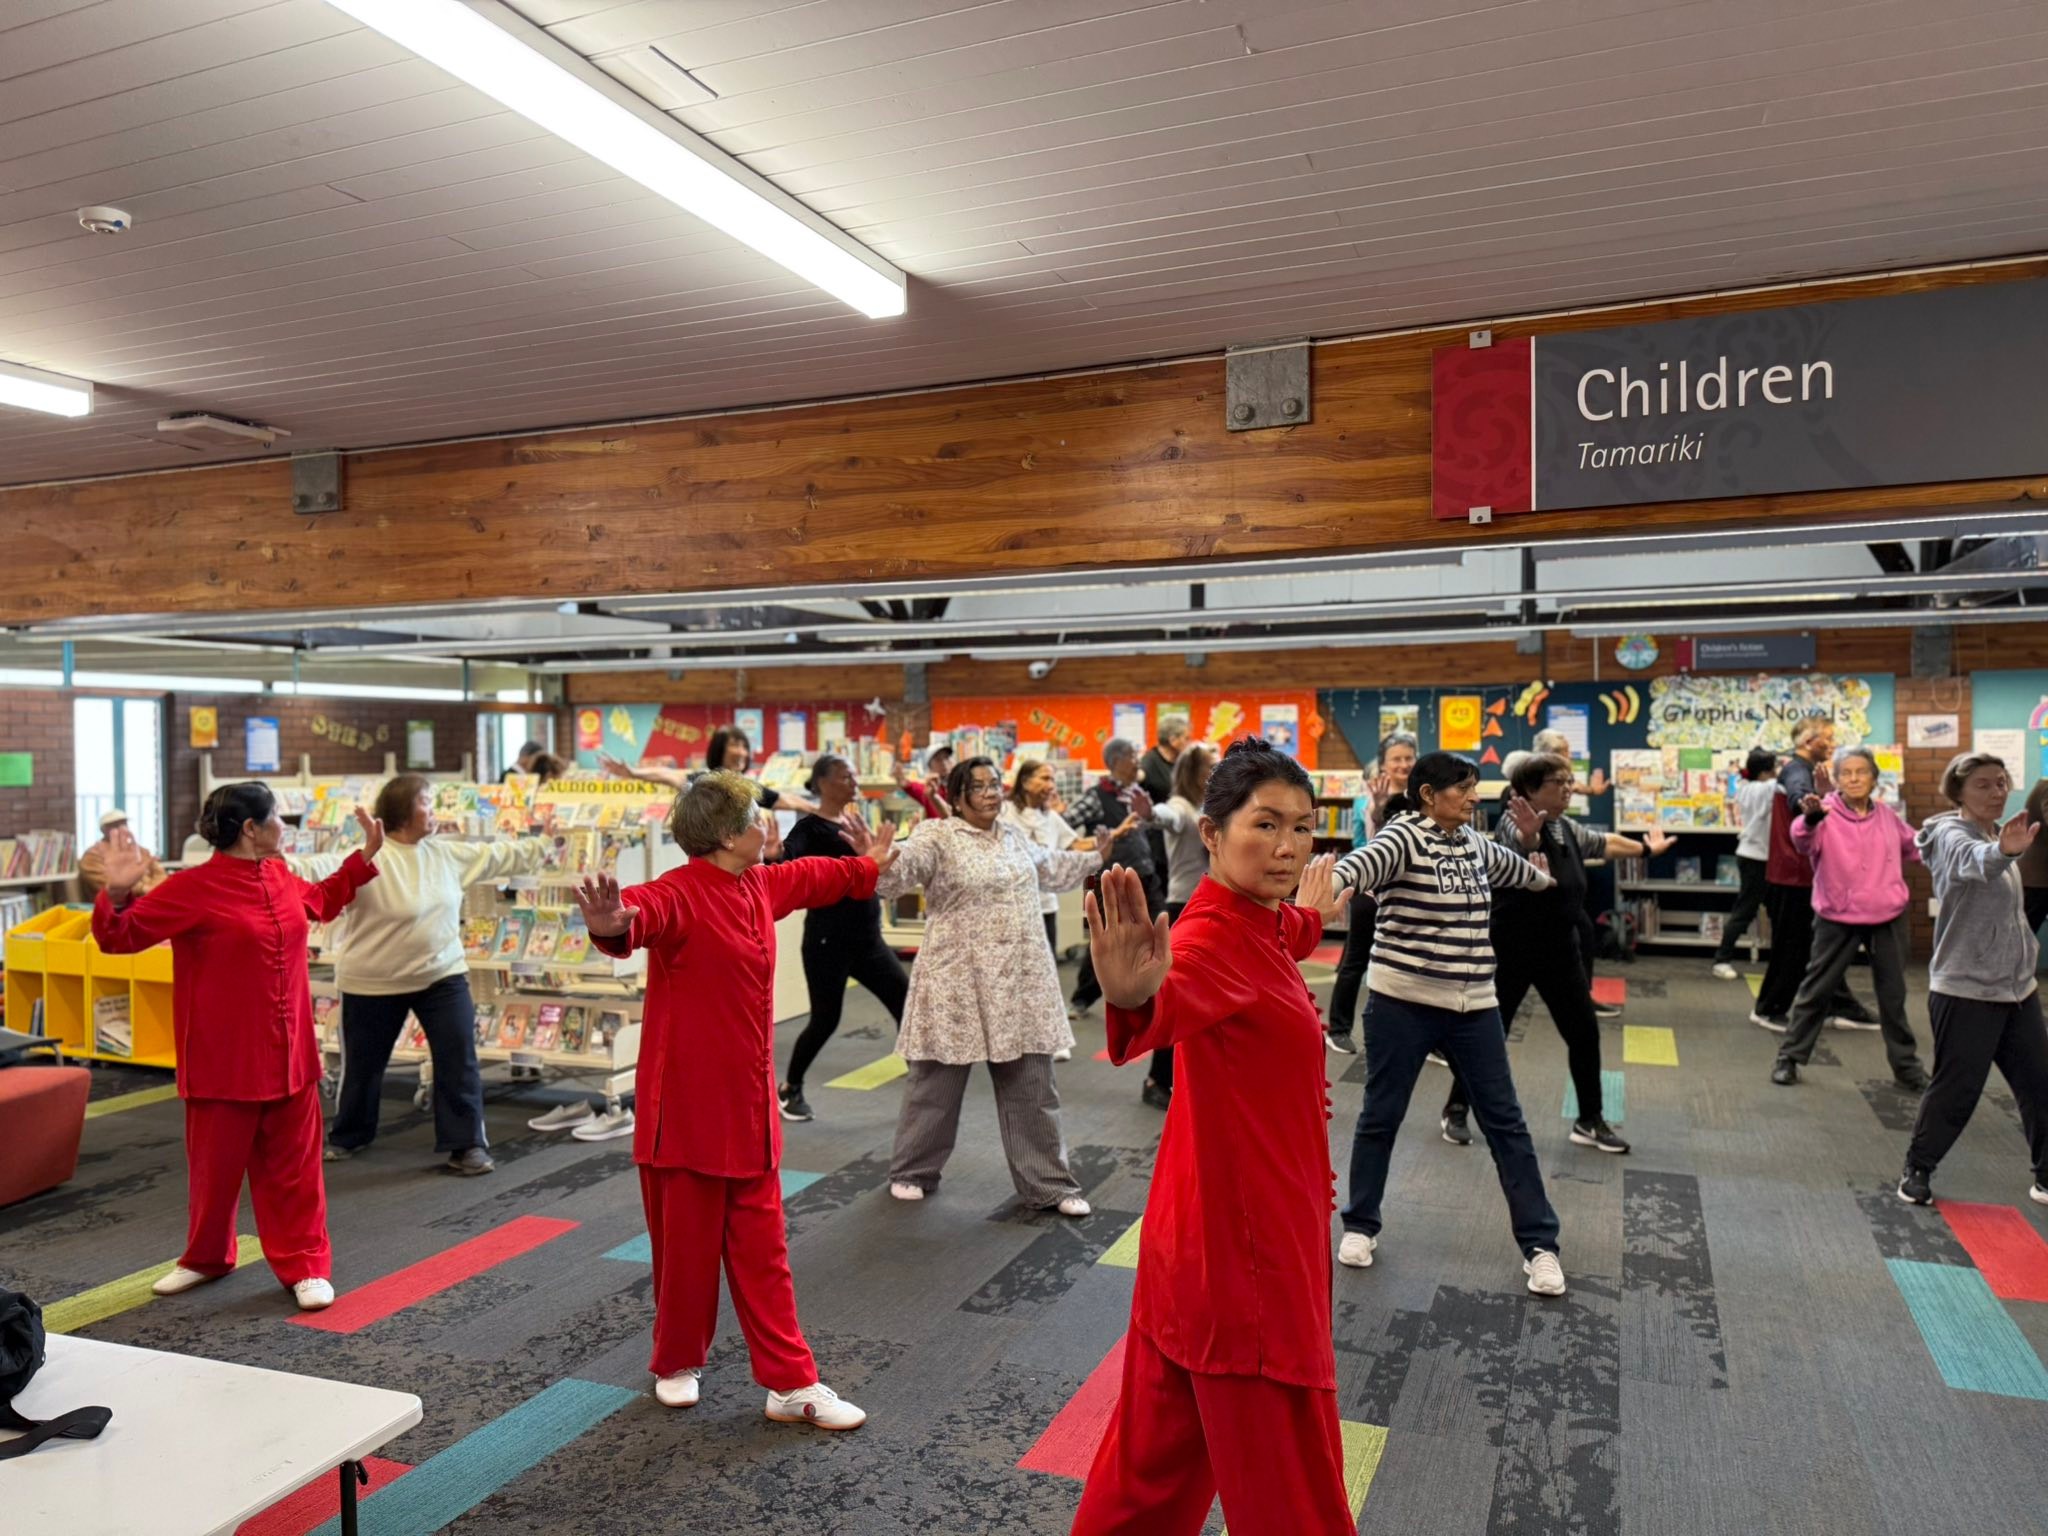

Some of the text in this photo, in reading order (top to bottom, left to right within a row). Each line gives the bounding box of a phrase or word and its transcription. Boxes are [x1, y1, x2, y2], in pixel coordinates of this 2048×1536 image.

[1577, 356, 1833, 422] Children
[1577, 432, 1704, 470] Tamariki
[1663, 703, 1755, 725] Graphic
[545, 780, 597, 793] AUDIO
